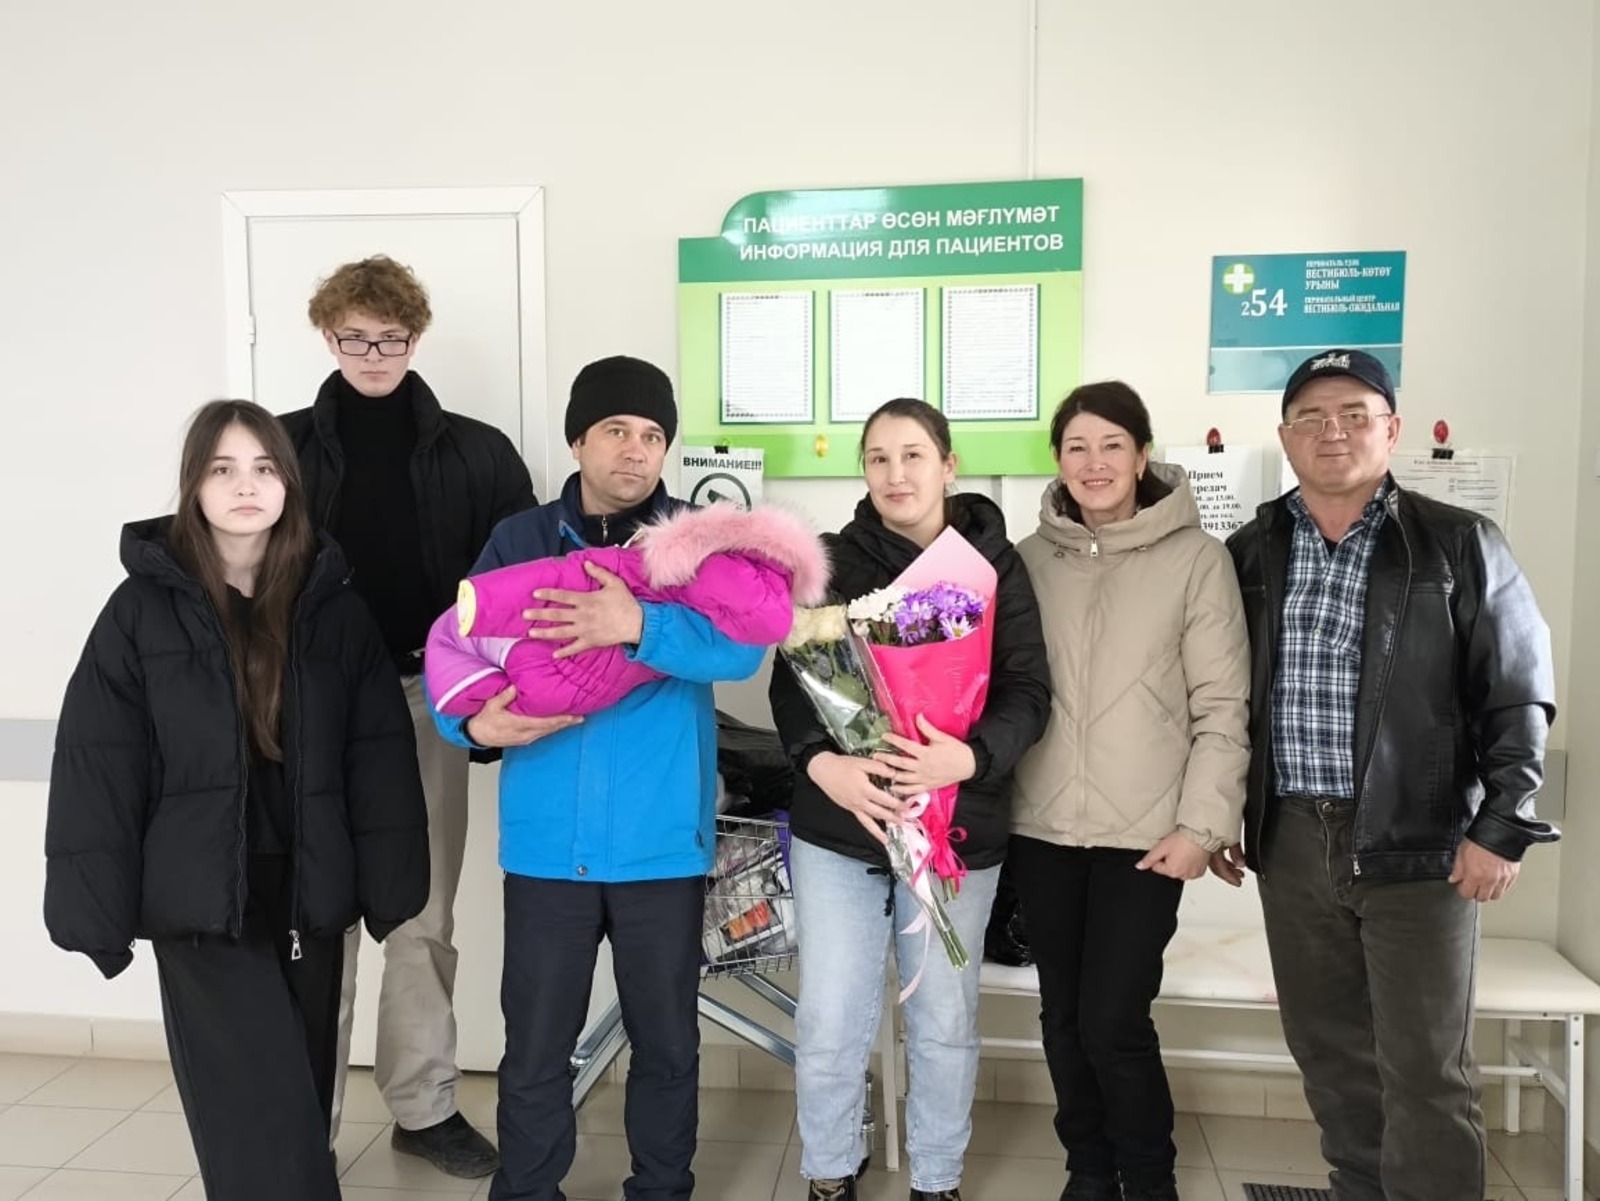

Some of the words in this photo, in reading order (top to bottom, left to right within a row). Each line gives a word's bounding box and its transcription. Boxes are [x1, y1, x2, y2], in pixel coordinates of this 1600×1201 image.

[743, 213, 877, 233] ПАЦИЕНТТАР
[881, 211, 941, 229] ӨСӨН
[740, 240, 883, 261] ИНФОРМАЦИЯ
[888, 239, 929, 259] ДЛЯ
[936, 234, 1064, 256] ПАЦИЕНТОВ
[1305, 279, 1339, 290] УРЫНЫ
[683, 456, 762, 471] ВНИМАНИЕ!!!
[1188, 470, 1223, 481] Прием
